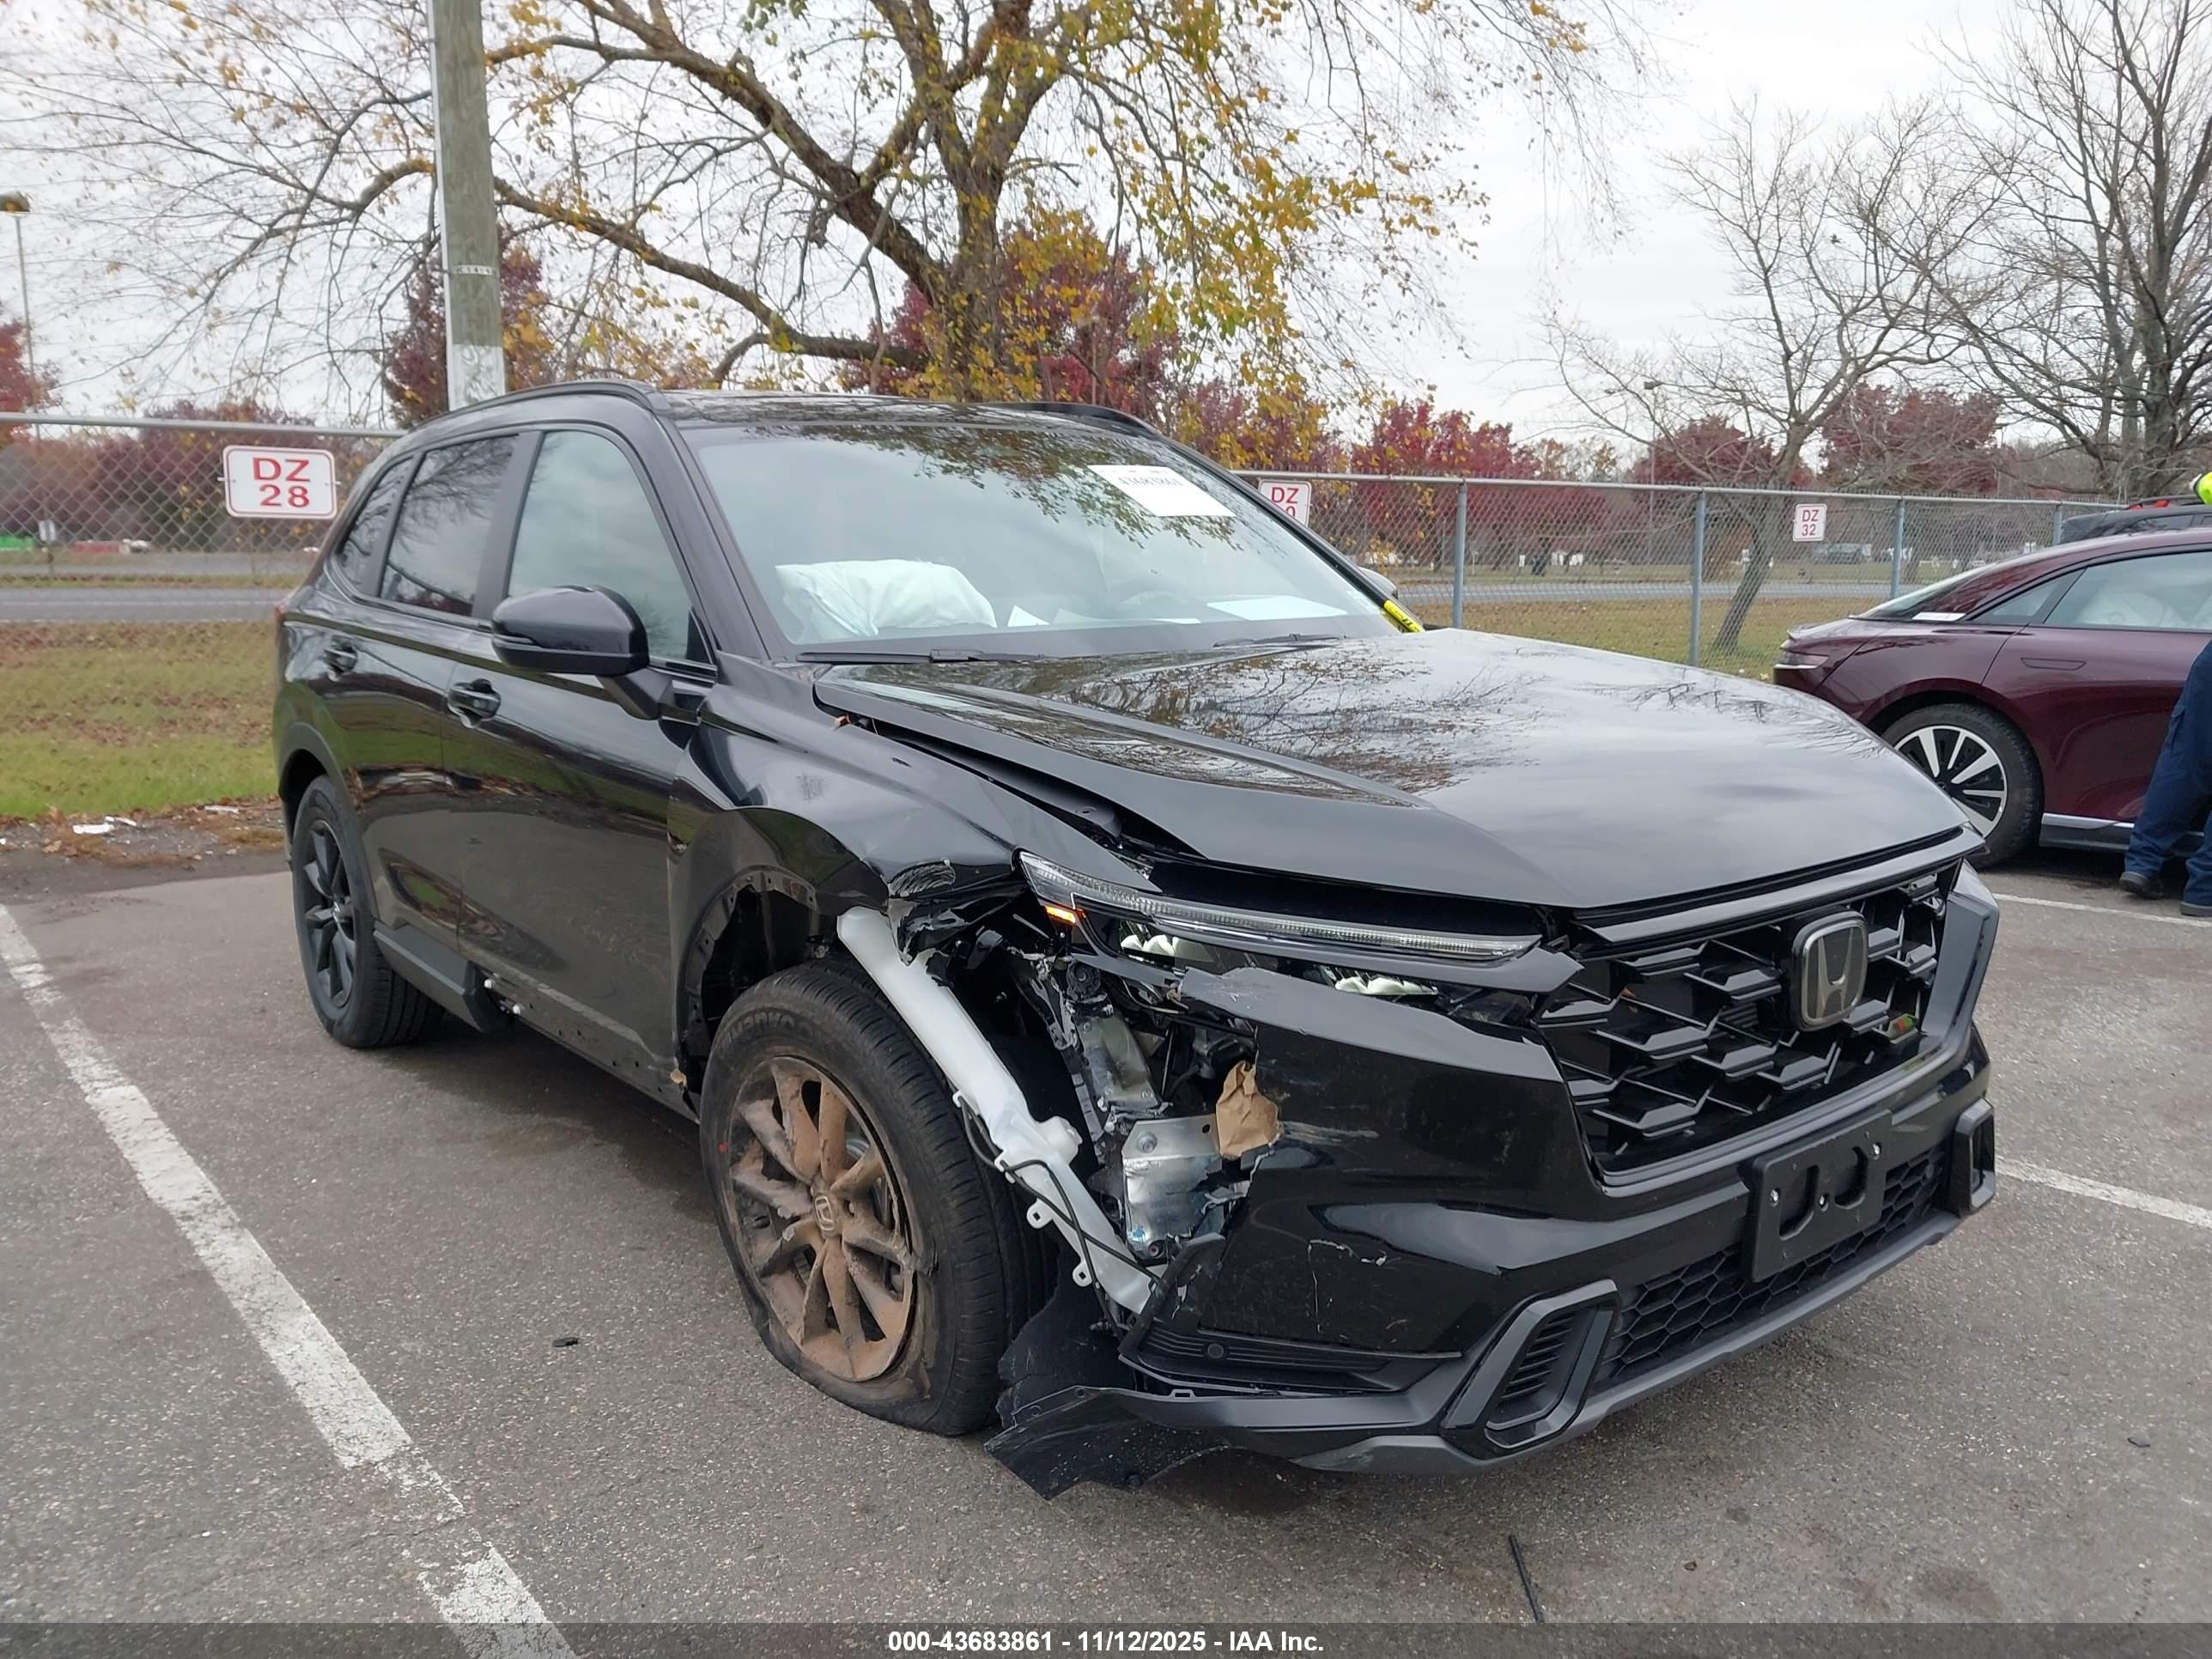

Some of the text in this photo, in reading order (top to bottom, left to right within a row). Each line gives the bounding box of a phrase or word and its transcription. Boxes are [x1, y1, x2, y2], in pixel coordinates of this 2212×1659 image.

[252, 457, 311, 482] DZ
[259, 484, 310, 508] 28
[1271, 486, 1299, 504] DZ
[1802, 509, 1820, 522] DZ
[1802, 523, 1816, 537] 32
